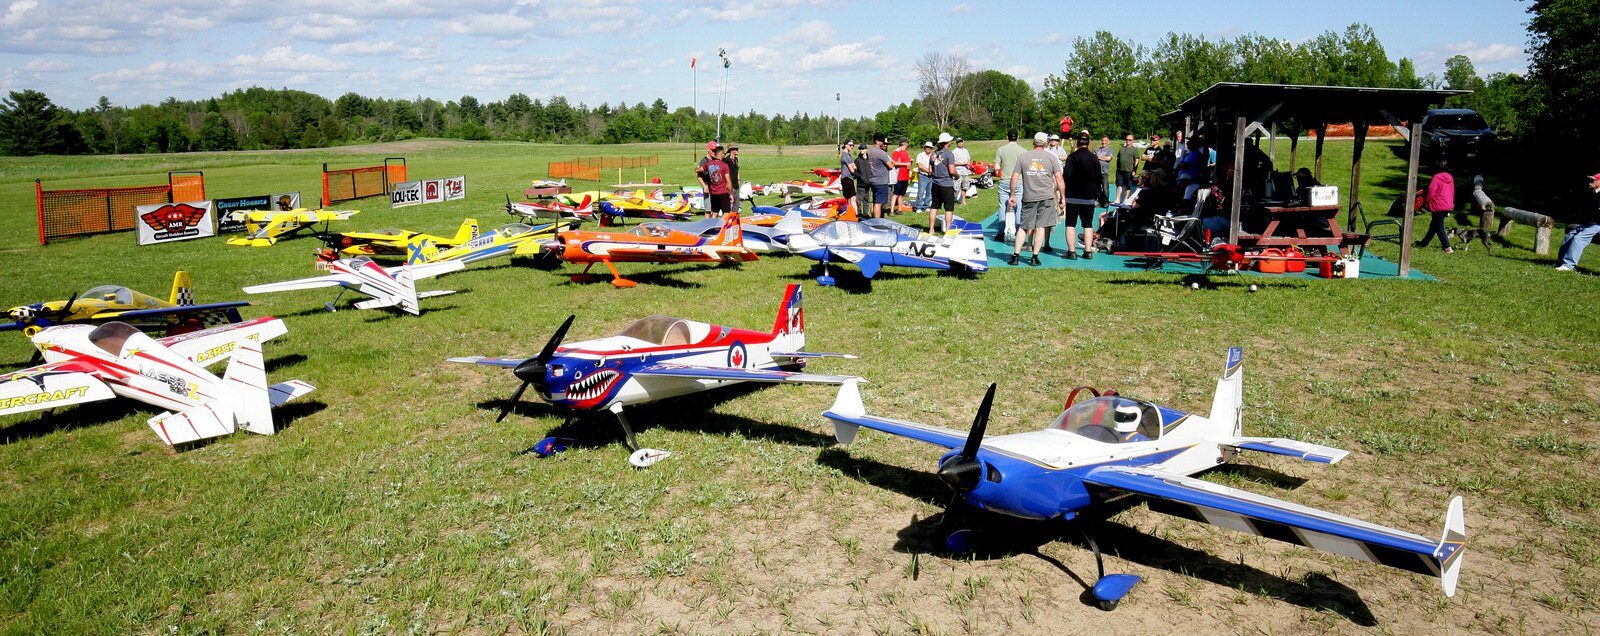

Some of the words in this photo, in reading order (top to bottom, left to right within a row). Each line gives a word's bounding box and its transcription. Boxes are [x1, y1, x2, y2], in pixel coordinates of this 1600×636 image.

[168, 221, 184, 229] AMR
[139, 364, 187, 389] LASER
[0, 385, 90, 411] IRCRAFT
